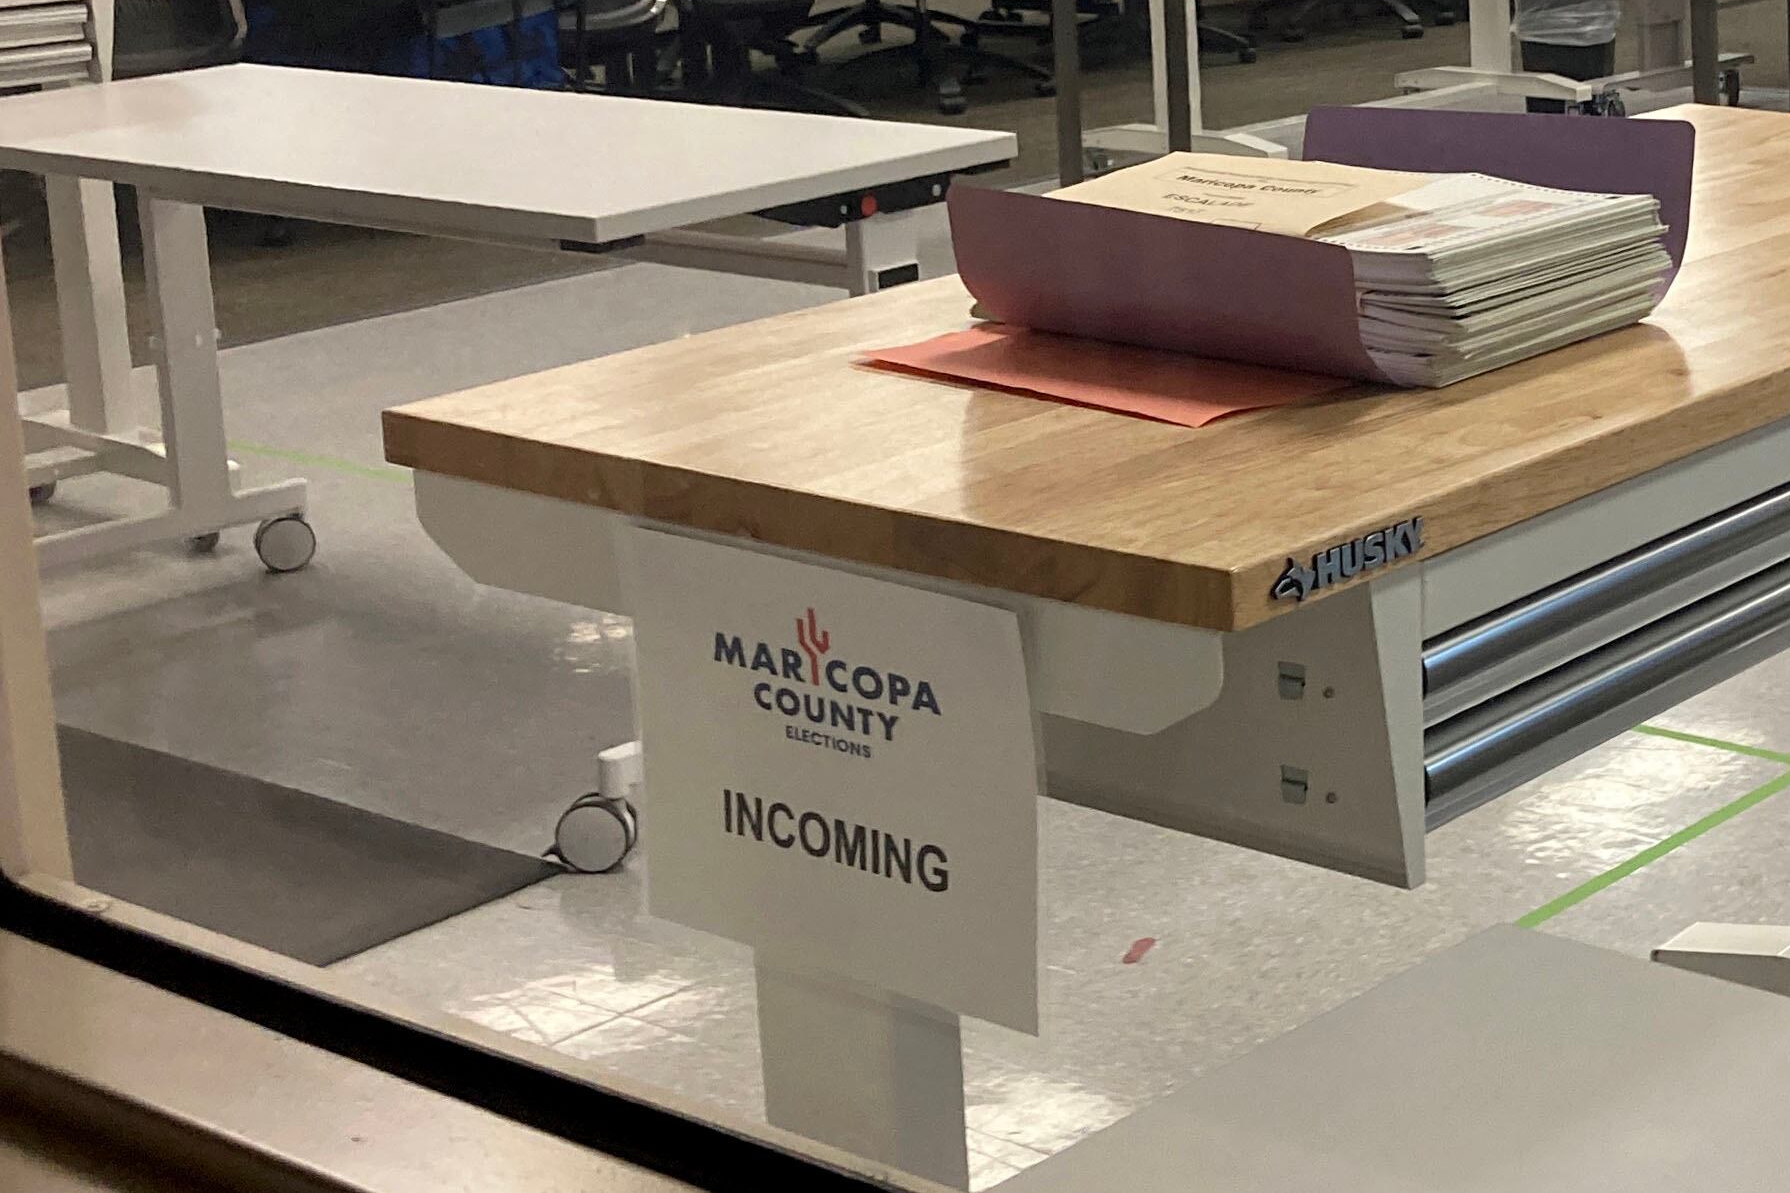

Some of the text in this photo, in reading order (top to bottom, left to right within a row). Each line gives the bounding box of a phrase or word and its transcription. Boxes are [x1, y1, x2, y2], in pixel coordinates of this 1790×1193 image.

[1175, 174, 1256, 191] Maricopa
[1312, 515, 1425, 591] HUSKY
[753, 681, 899, 742] COUNTY
[785, 725, 872, 759] ELECTIONS
[723, 788, 949, 893] INCOMING
